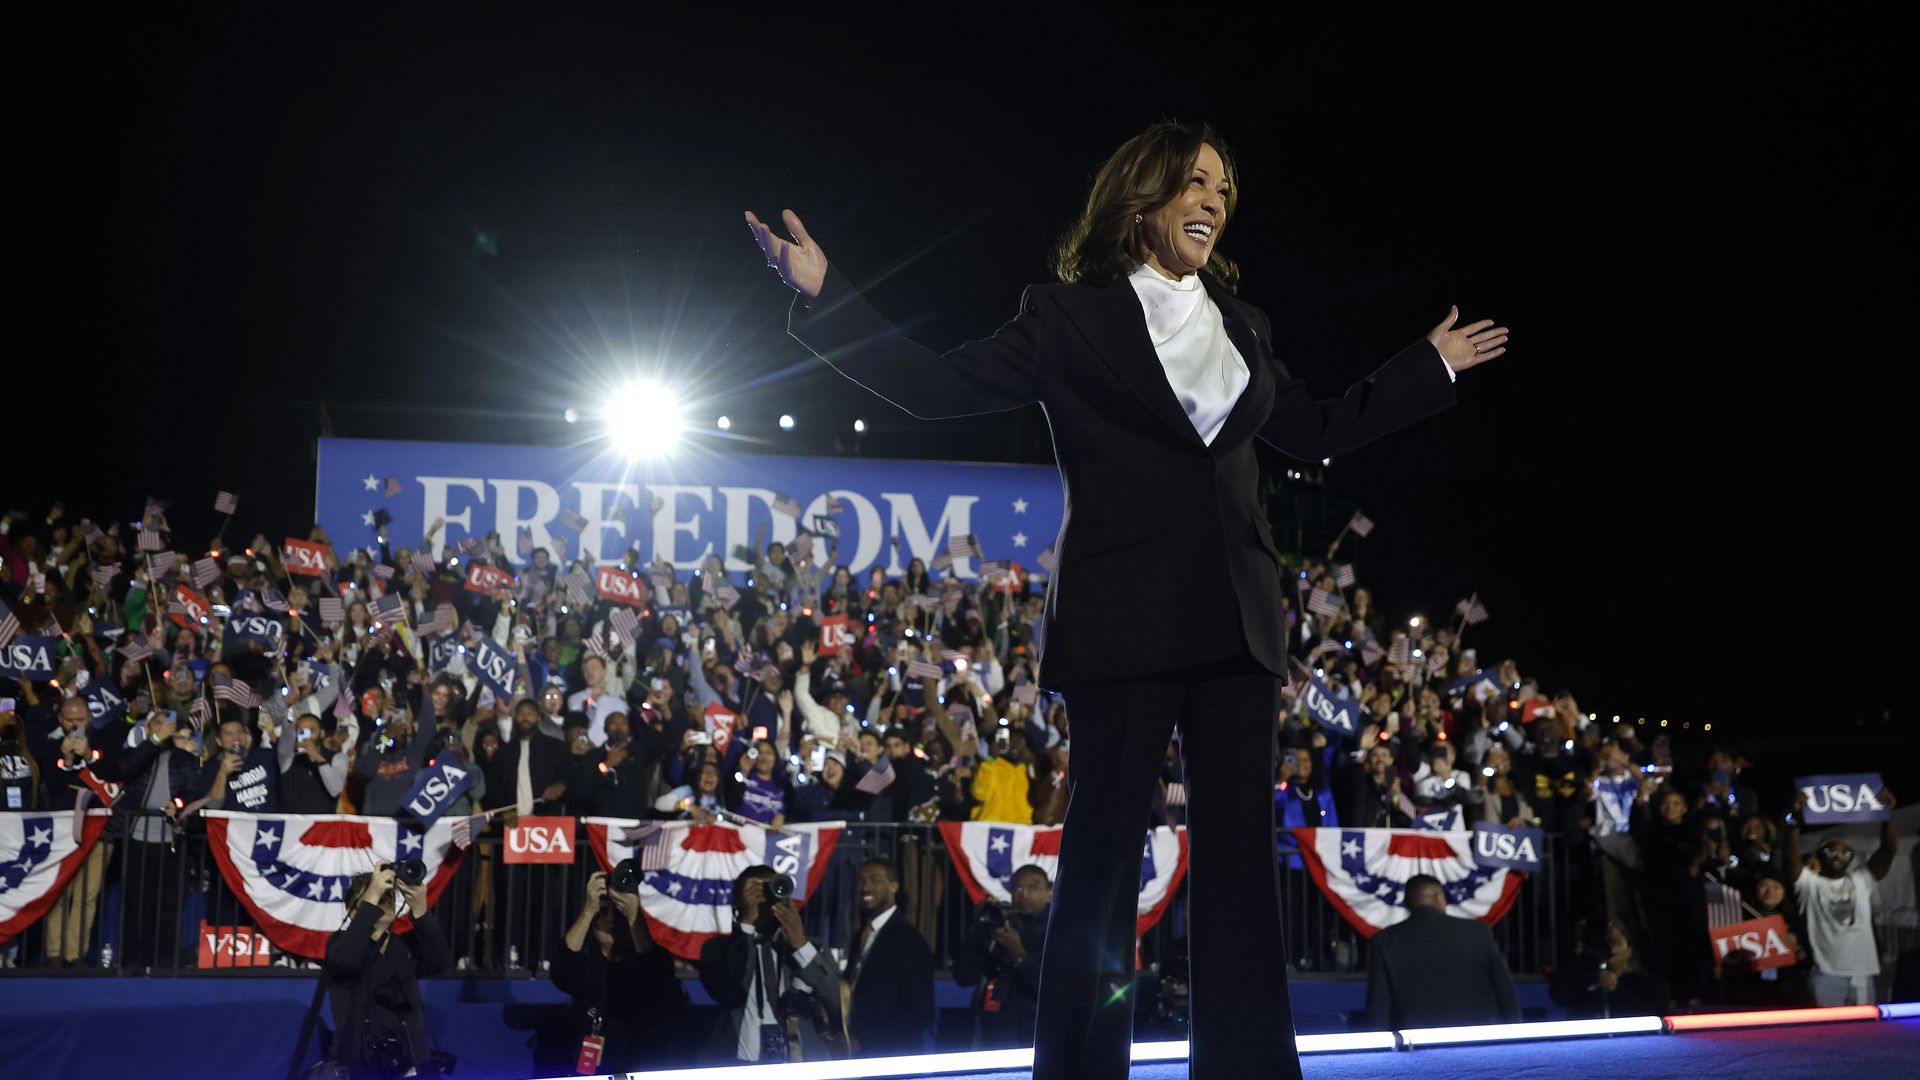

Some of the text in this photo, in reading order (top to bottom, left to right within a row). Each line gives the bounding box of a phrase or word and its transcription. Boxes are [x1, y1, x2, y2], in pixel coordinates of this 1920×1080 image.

[416, 476, 980, 578] FREEDOM
[471, 567, 510, 588] US
[599, 573, 640, 599] USA
[477, 641, 516, 695] USA
[88, 687, 121, 718] SA
[1306, 684, 1352, 731] USA
[408, 764, 468, 817] USA
[1801, 783, 1886, 814] USA
[510, 826, 572, 854] USA
[1477, 830, 1538, 862] USA
[773, 834, 801, 889] SA
[1715, 928, 1791, 960] USA
